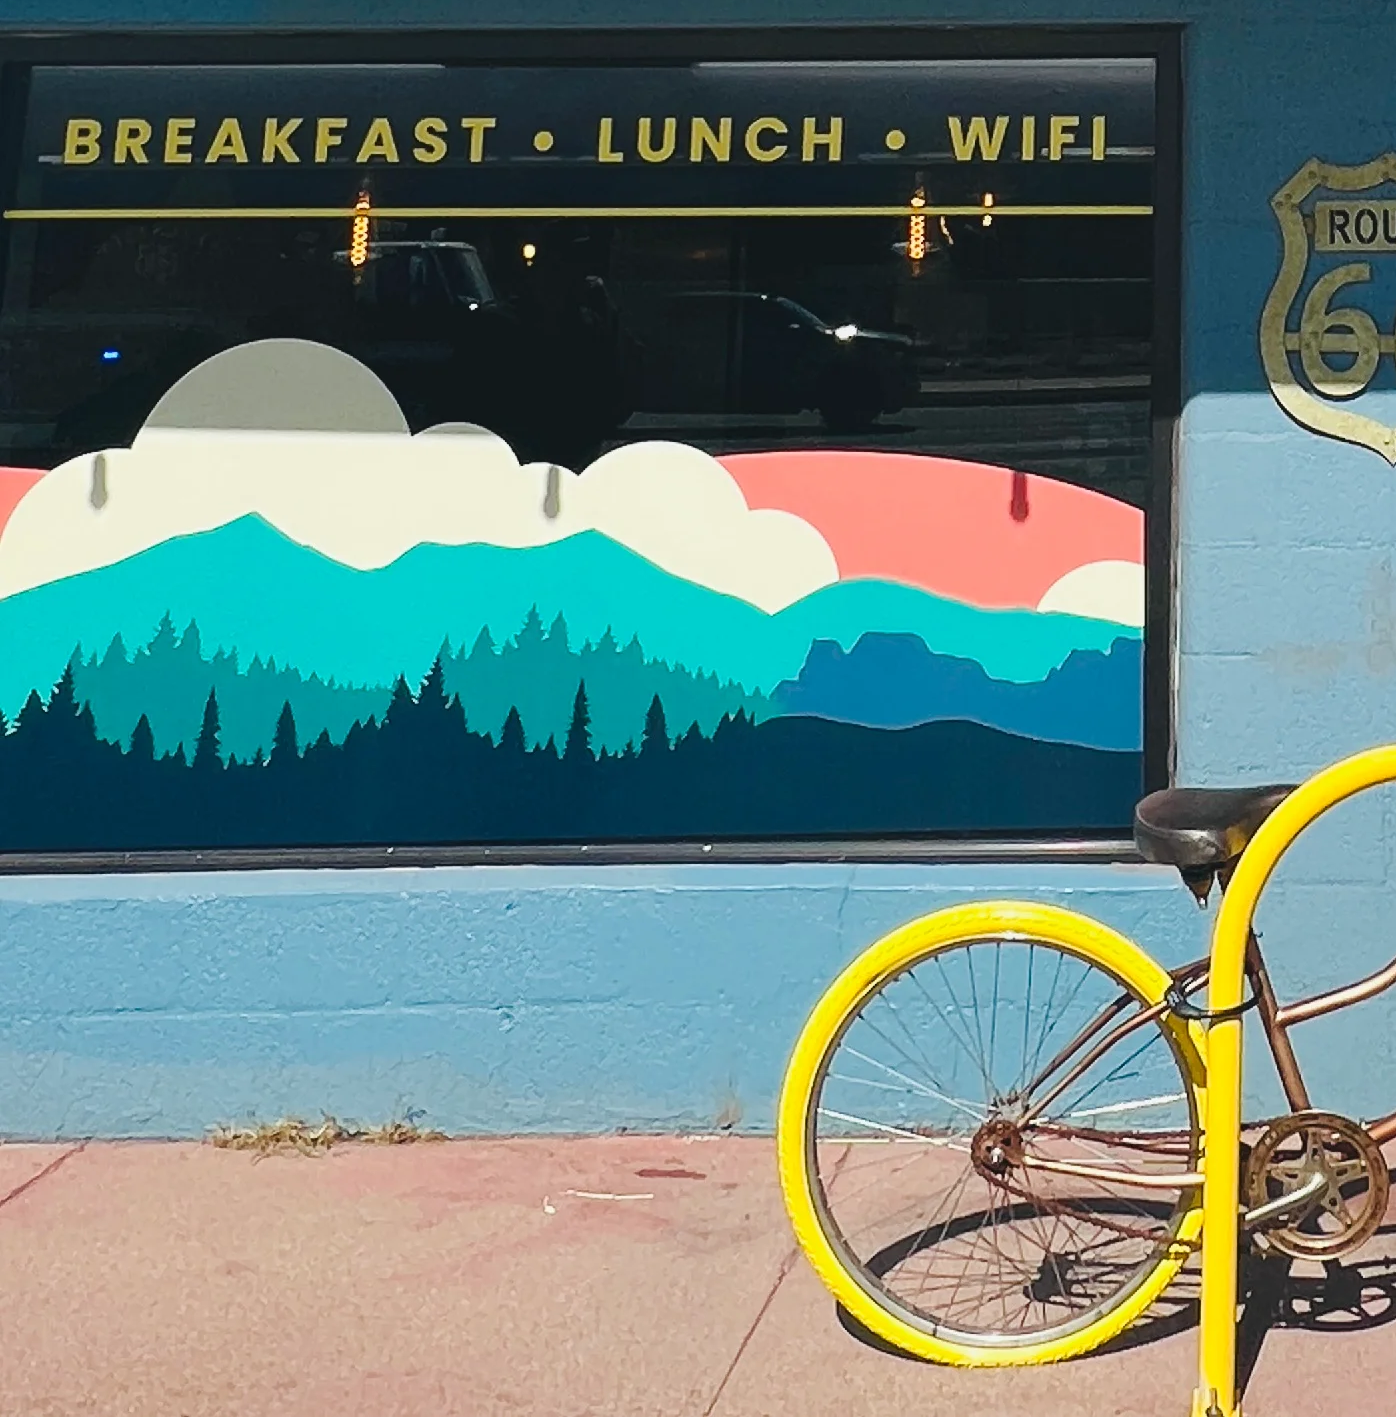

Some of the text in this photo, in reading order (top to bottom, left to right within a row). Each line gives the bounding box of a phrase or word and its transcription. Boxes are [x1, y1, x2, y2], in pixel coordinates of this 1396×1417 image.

[63, 114, 1107, 166] BREAKFAST LUNCH WIFI
